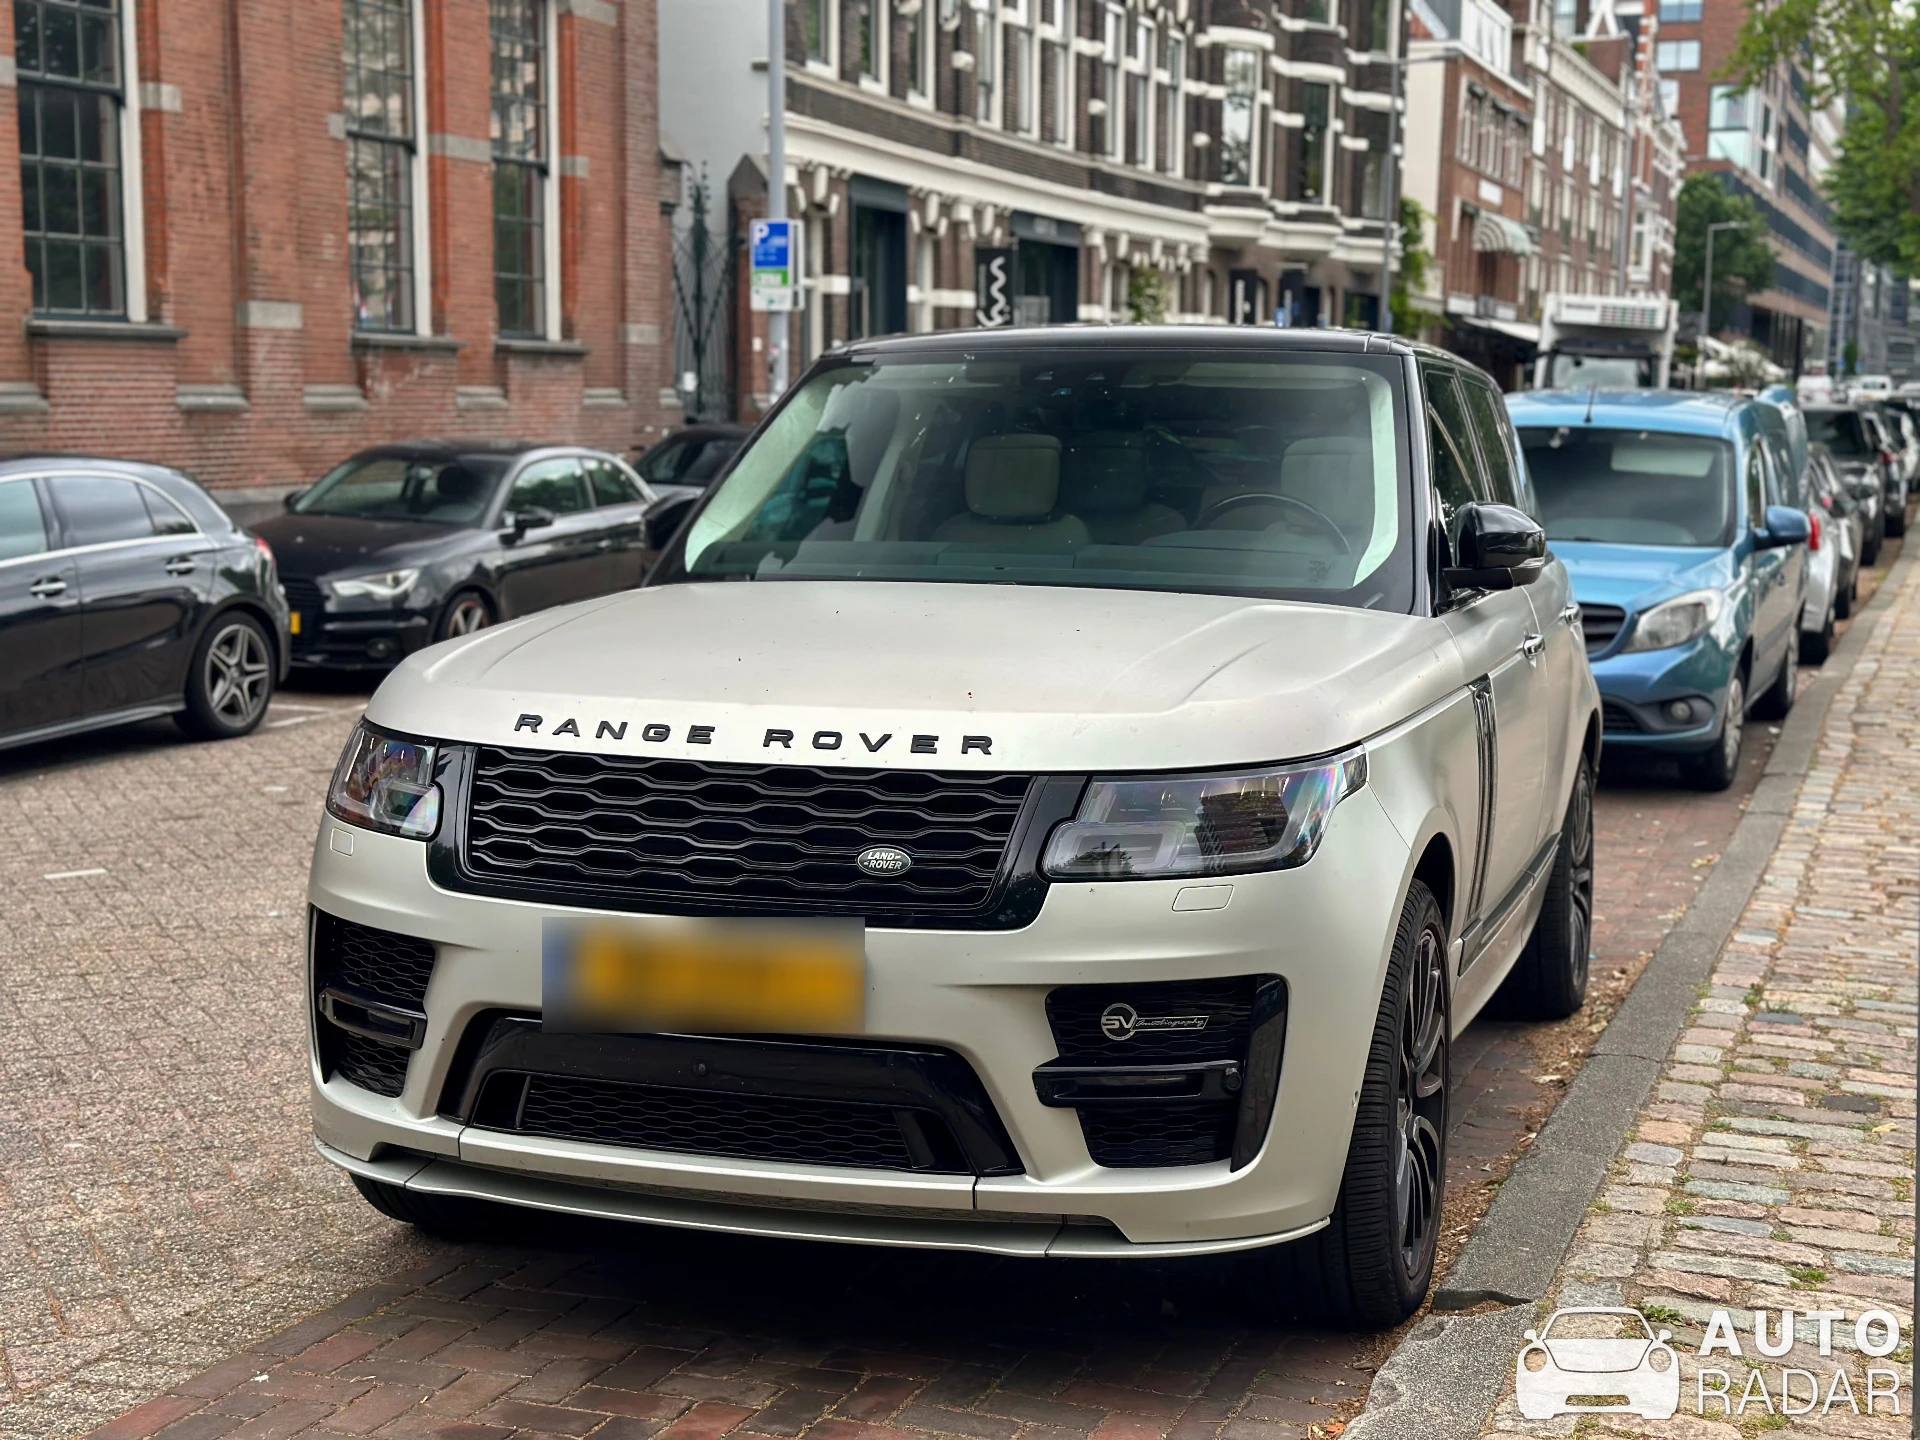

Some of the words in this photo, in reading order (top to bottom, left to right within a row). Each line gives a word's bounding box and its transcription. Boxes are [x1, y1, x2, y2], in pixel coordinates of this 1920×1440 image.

[754, 223, 770, 245] P
[514, 713, 716, 745] RANGE
[763, 728, 994, 755] ROVER
[867, 852, 895, 860] LAND
[868, 860, 902, 869] ROVER
